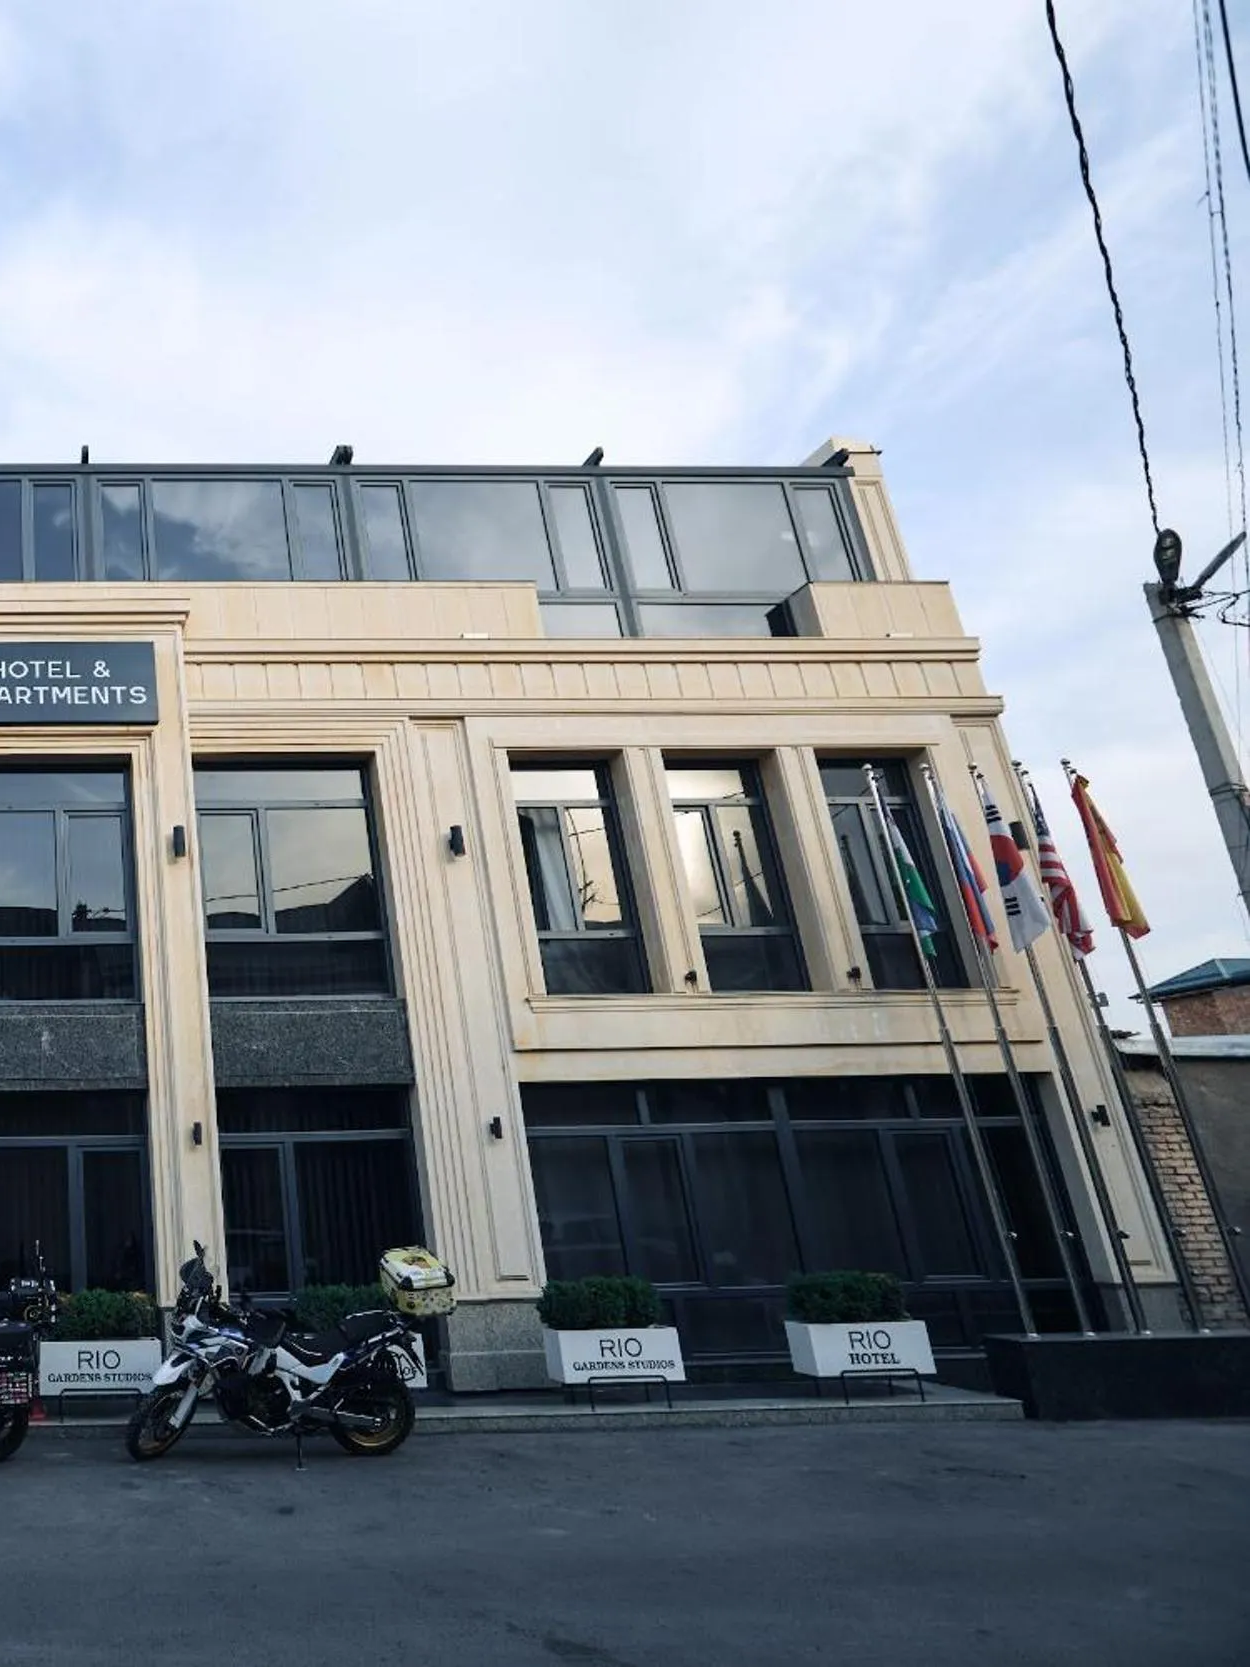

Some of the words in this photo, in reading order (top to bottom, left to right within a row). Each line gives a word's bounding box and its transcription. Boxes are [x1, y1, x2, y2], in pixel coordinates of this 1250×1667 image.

[93, 659, 111, 678] &
[600, 1338, 642, 1357] RIO
[848, 1330, 891, 1349] RIO
[78, 1350, 121, 1370] RIO
[572, 1361, 626, 1371] GARDENS
[628, 1359, 676, 1369] STUDIOS
[848, 1352, 901, 1365] HOTEL
[48, 1372, 101, 1382] GARDENS
[103, 1372, 153, 1382] STUDIOS
